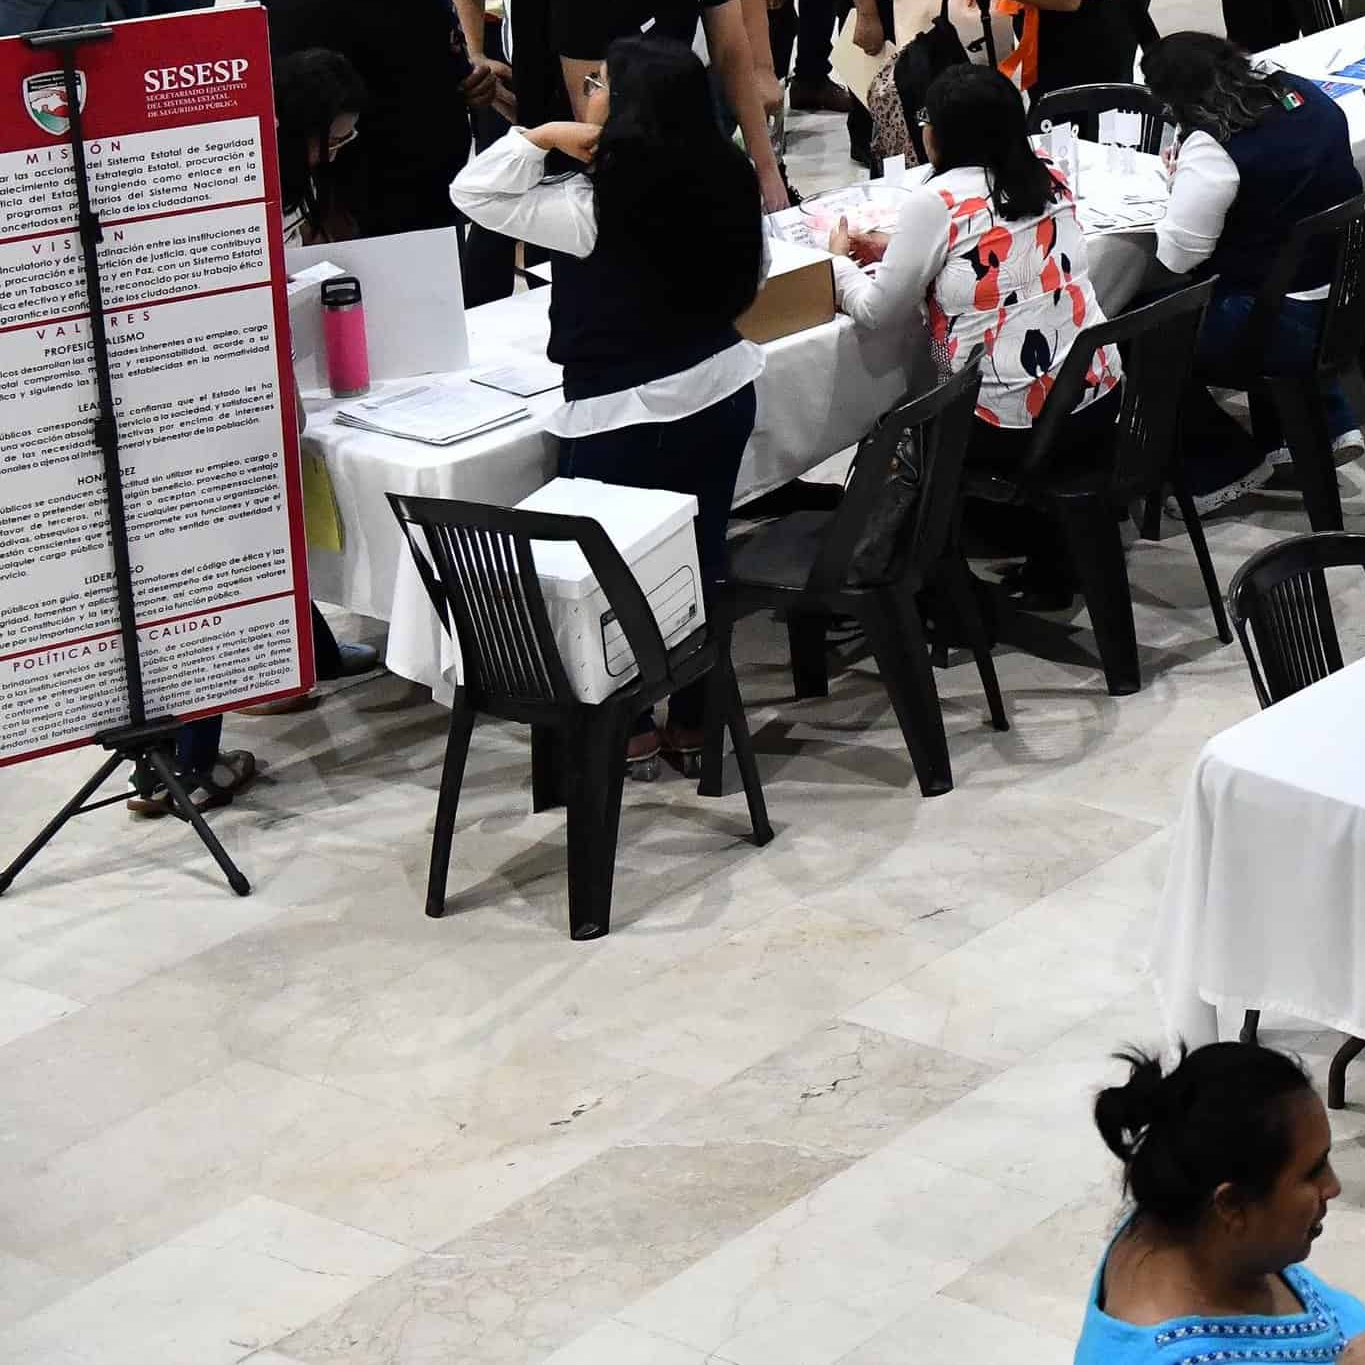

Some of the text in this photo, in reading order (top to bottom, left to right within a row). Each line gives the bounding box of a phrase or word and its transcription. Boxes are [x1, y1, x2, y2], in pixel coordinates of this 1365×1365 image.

[144, 59, 249, 93] SESESP
[146, 82, 248, 102] SECRETARIADO EJECUTIVO
[164, 97, 196, 108] SISTEMA
[198, 93, 229, 102] ESTATAL
[159, 104, 205, 116] SEGURIDAD
[25, 140, 121, 164] MISÓN
[33, 163, 75, 178] accione
[106, 154, 145, 166] Sistema
[150, 147, 182, 160] Estatal
[204, 137, 254, 151] Seguridad
[95, 166, 143, 180] Estrategia
[185, 151, 244, 168] procuración
[6, 204, 63, 221] programas
[148, 185, 187, 196] Sistema
[192, 175, 238, 190] Nacional
[28, 193, 45, 203] del
[50, 187, 78, 200] Estad
[94, 178, 146, 193] fungiendo
[157, 173, 182, 183] como
[187, 167, 222, 178] enlace
[31, 230, 124, 254] VISN
[145, 239, 171, 249] entre
[187, 227, 246, 242] instituciones
[4, 268, 66, 288] procuración
[189, 245, 208, 255] que
[210, 236, 261, 250] contribuya
[29, 281, 72, 293] Tabasco
[156, 263, 176, 272] con
[192, 254, 229, 265] Sistema
[231, 246, 262, 259] Estatal
[17, 295, 58, 308] efectivo
[114, 275, 172, 291] reconocido
[172, 272, 190, 282] por
[203, 263, 238, 276] trabajo
[239, 260, 263, 269] ético
[0, 309, 48, 325] garantice
[35, 310, 151, 340] VALRES
[44, 330, 145, 357] PROFESIOALISMO
[12, 615, 221, 672] POLÍTICA DE CALIDAD
